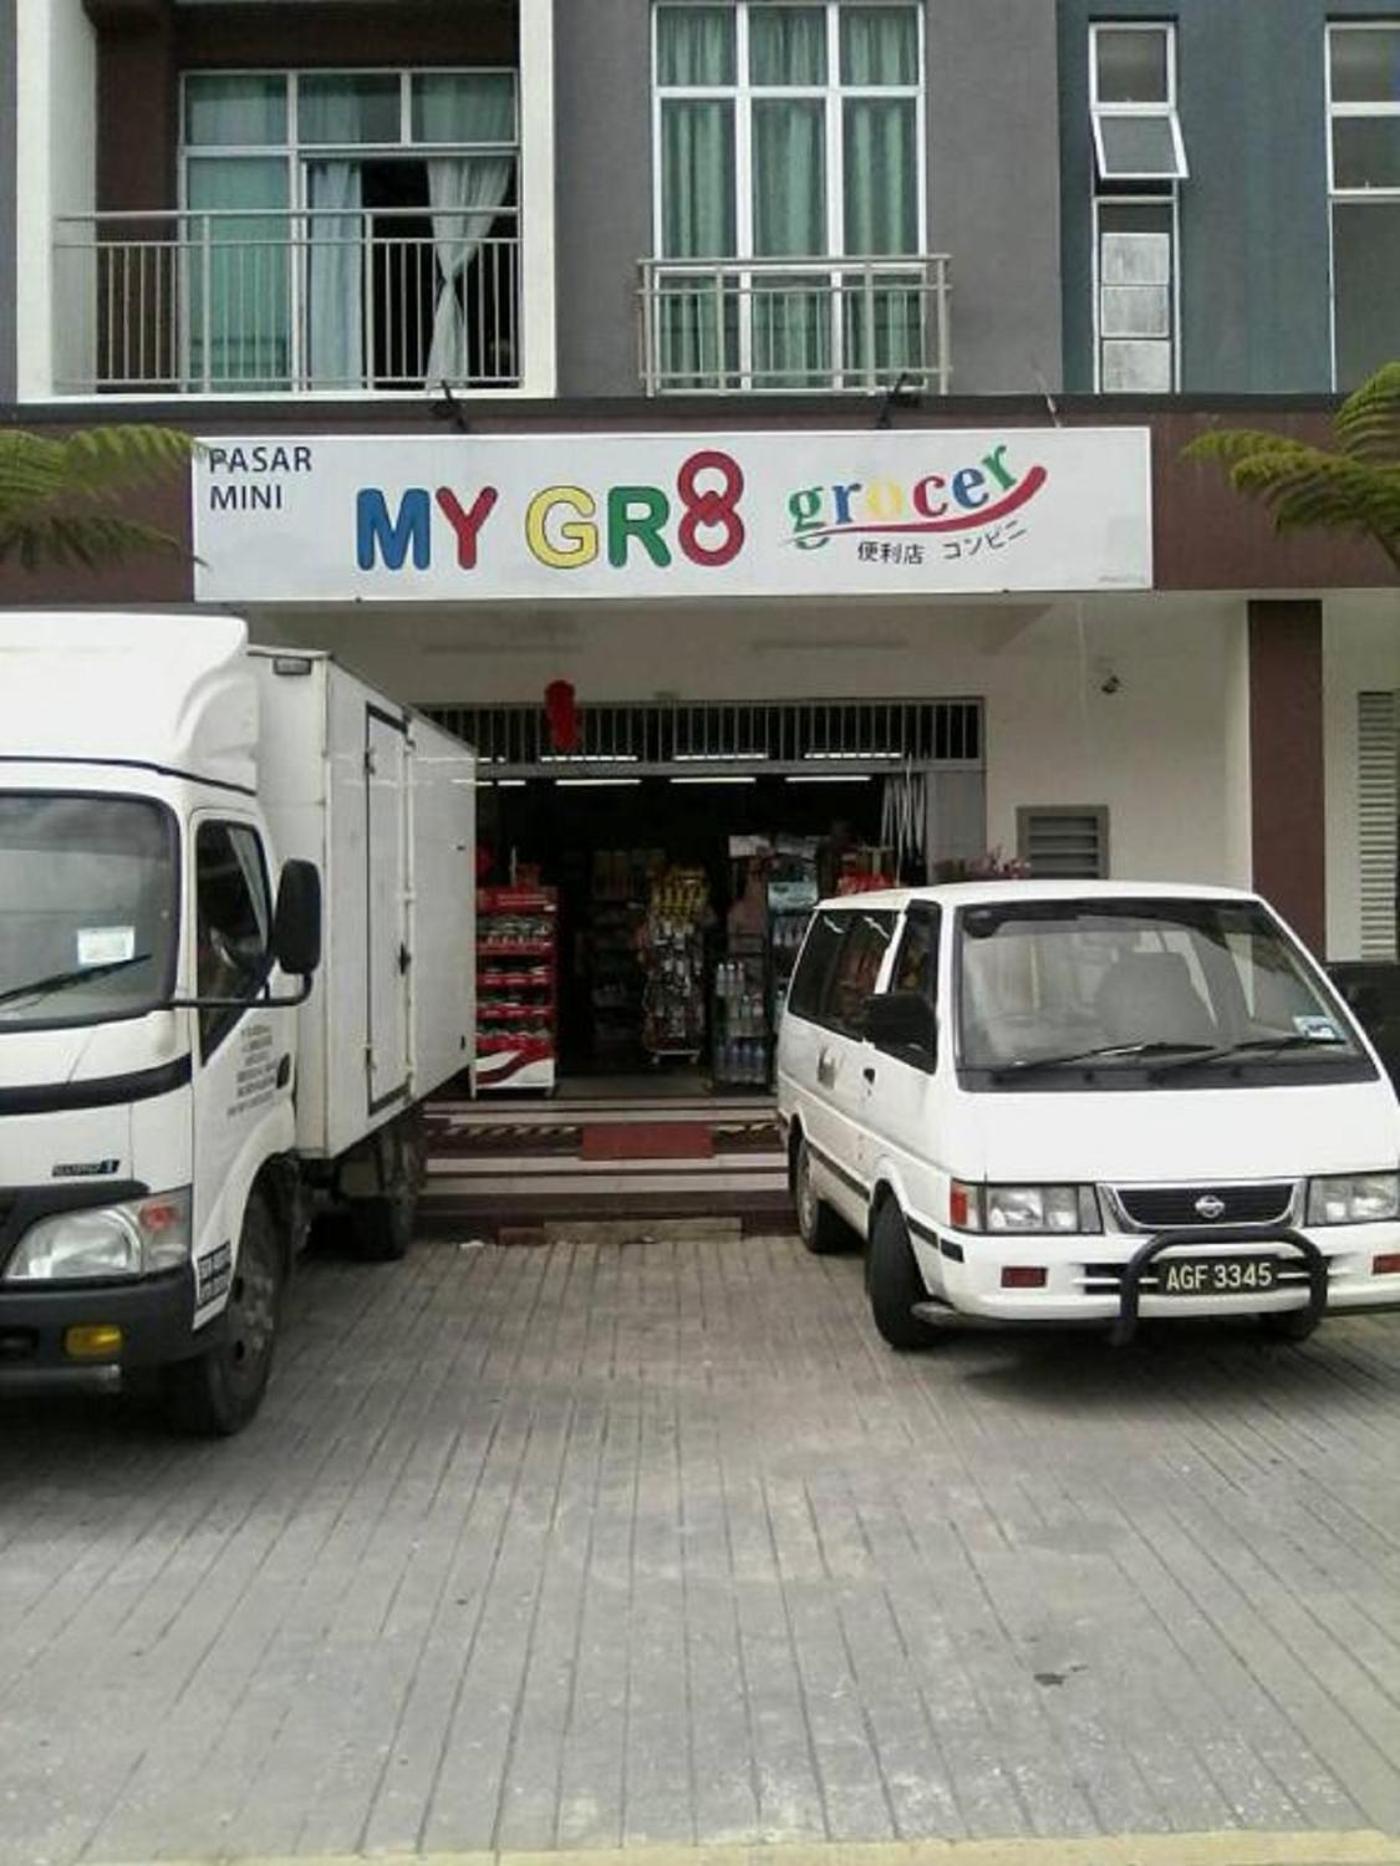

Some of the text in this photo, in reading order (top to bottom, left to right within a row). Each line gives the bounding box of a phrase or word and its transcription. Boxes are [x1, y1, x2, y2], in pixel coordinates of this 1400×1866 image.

[208, 445, 312, 473] PASAR
[209, 485, 282, 510] MINI
[356, 444, 1018, 570] MY GR8 grocer
[857, 541, 926, 565] 便利店
[942, 519, 1028, 560] コンビニ
[1166, 1261, 1273, 1291] AGF 3345
